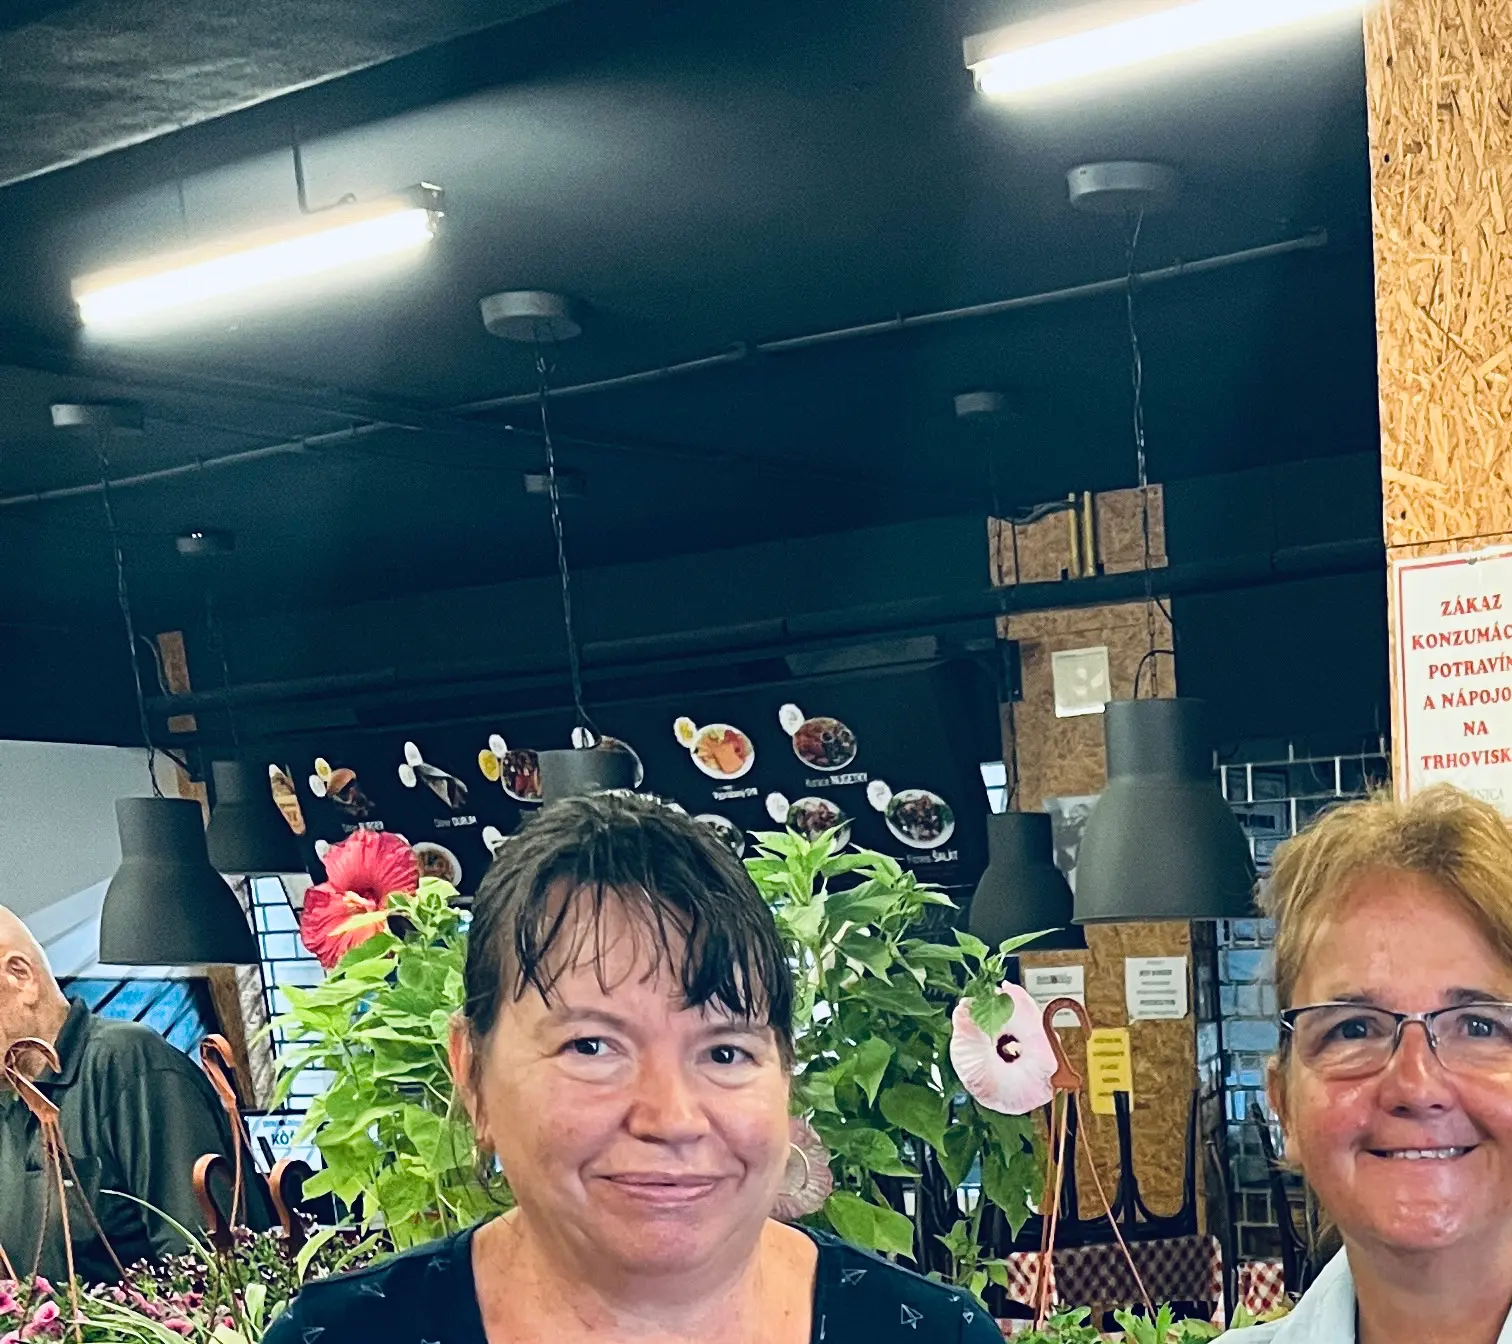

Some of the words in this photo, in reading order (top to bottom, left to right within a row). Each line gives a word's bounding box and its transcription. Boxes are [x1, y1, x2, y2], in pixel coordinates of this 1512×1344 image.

[1441, 594, 1502, 616] ZÁKAZ
[1424, 695, 1435, 710] A
[1463, 720, 1488, 736] NA
